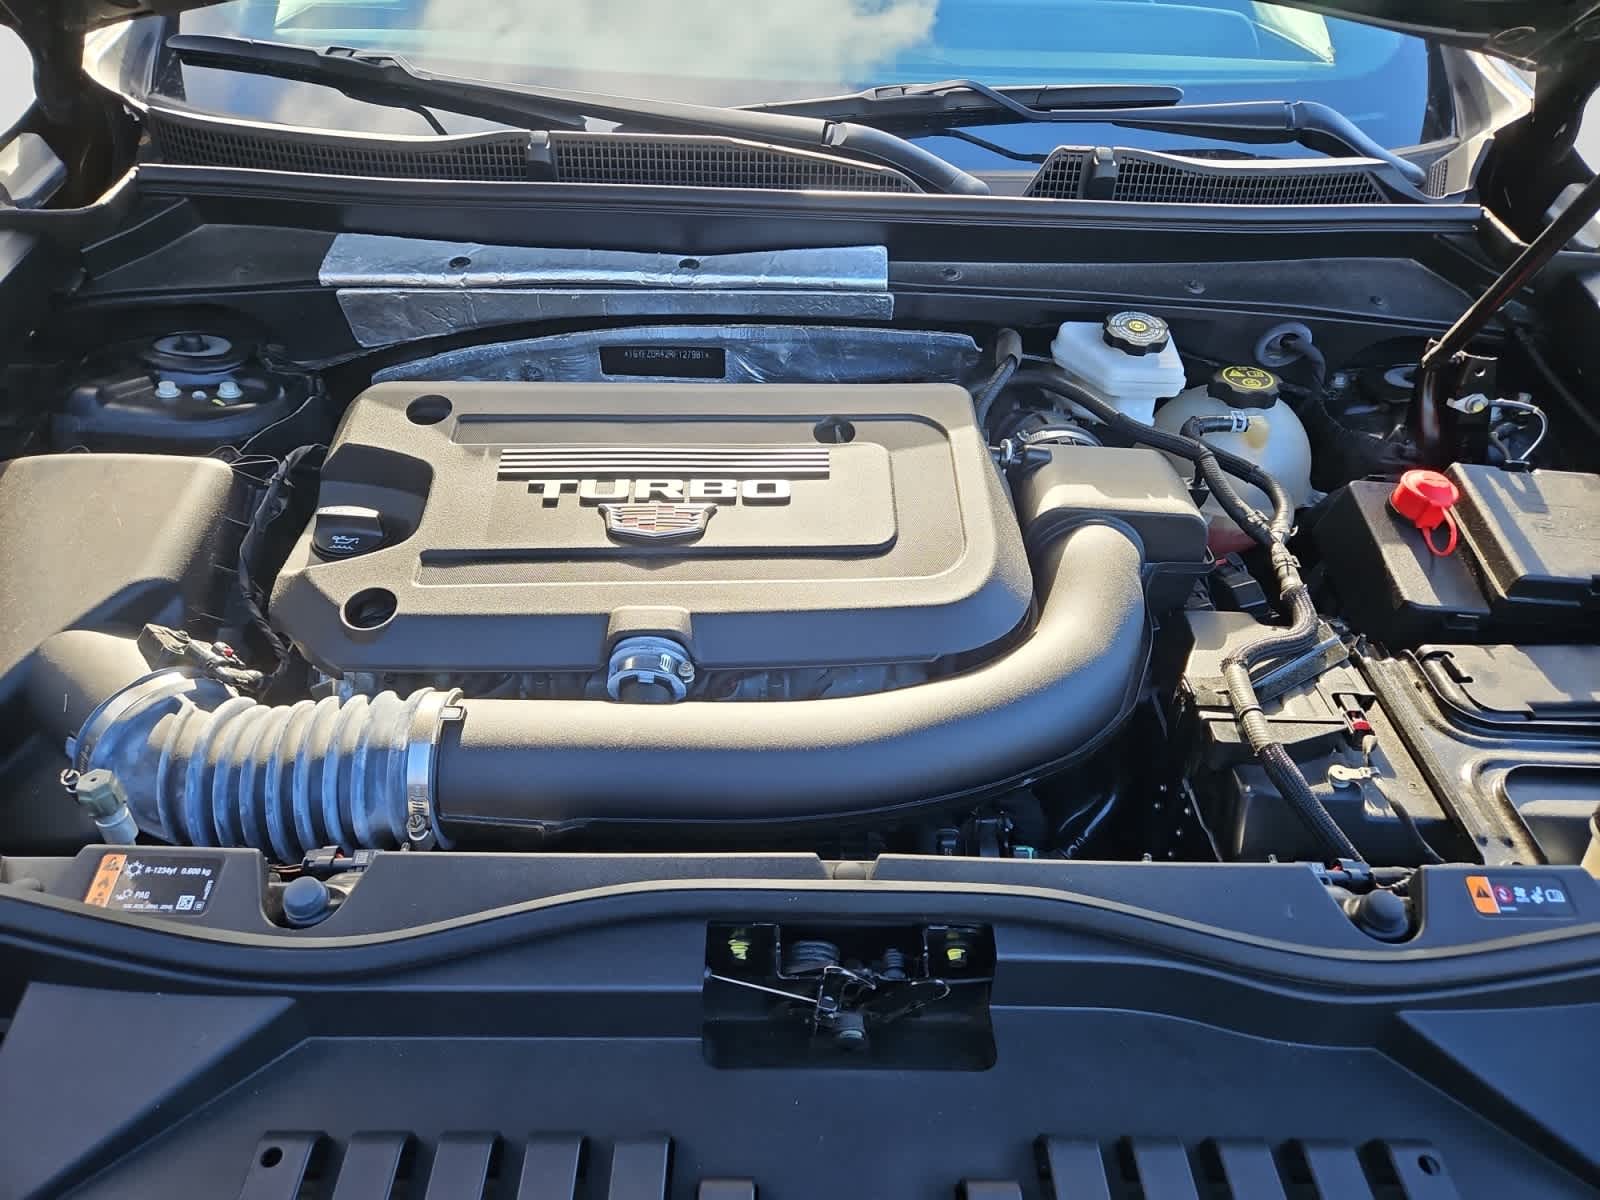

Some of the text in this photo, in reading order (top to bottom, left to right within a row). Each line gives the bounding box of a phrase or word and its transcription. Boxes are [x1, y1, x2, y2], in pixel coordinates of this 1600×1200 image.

[528, 479, 791, 507] TURBO
[202, 868, 212, 877] kg
[134, 890, 151, 899] PAG
